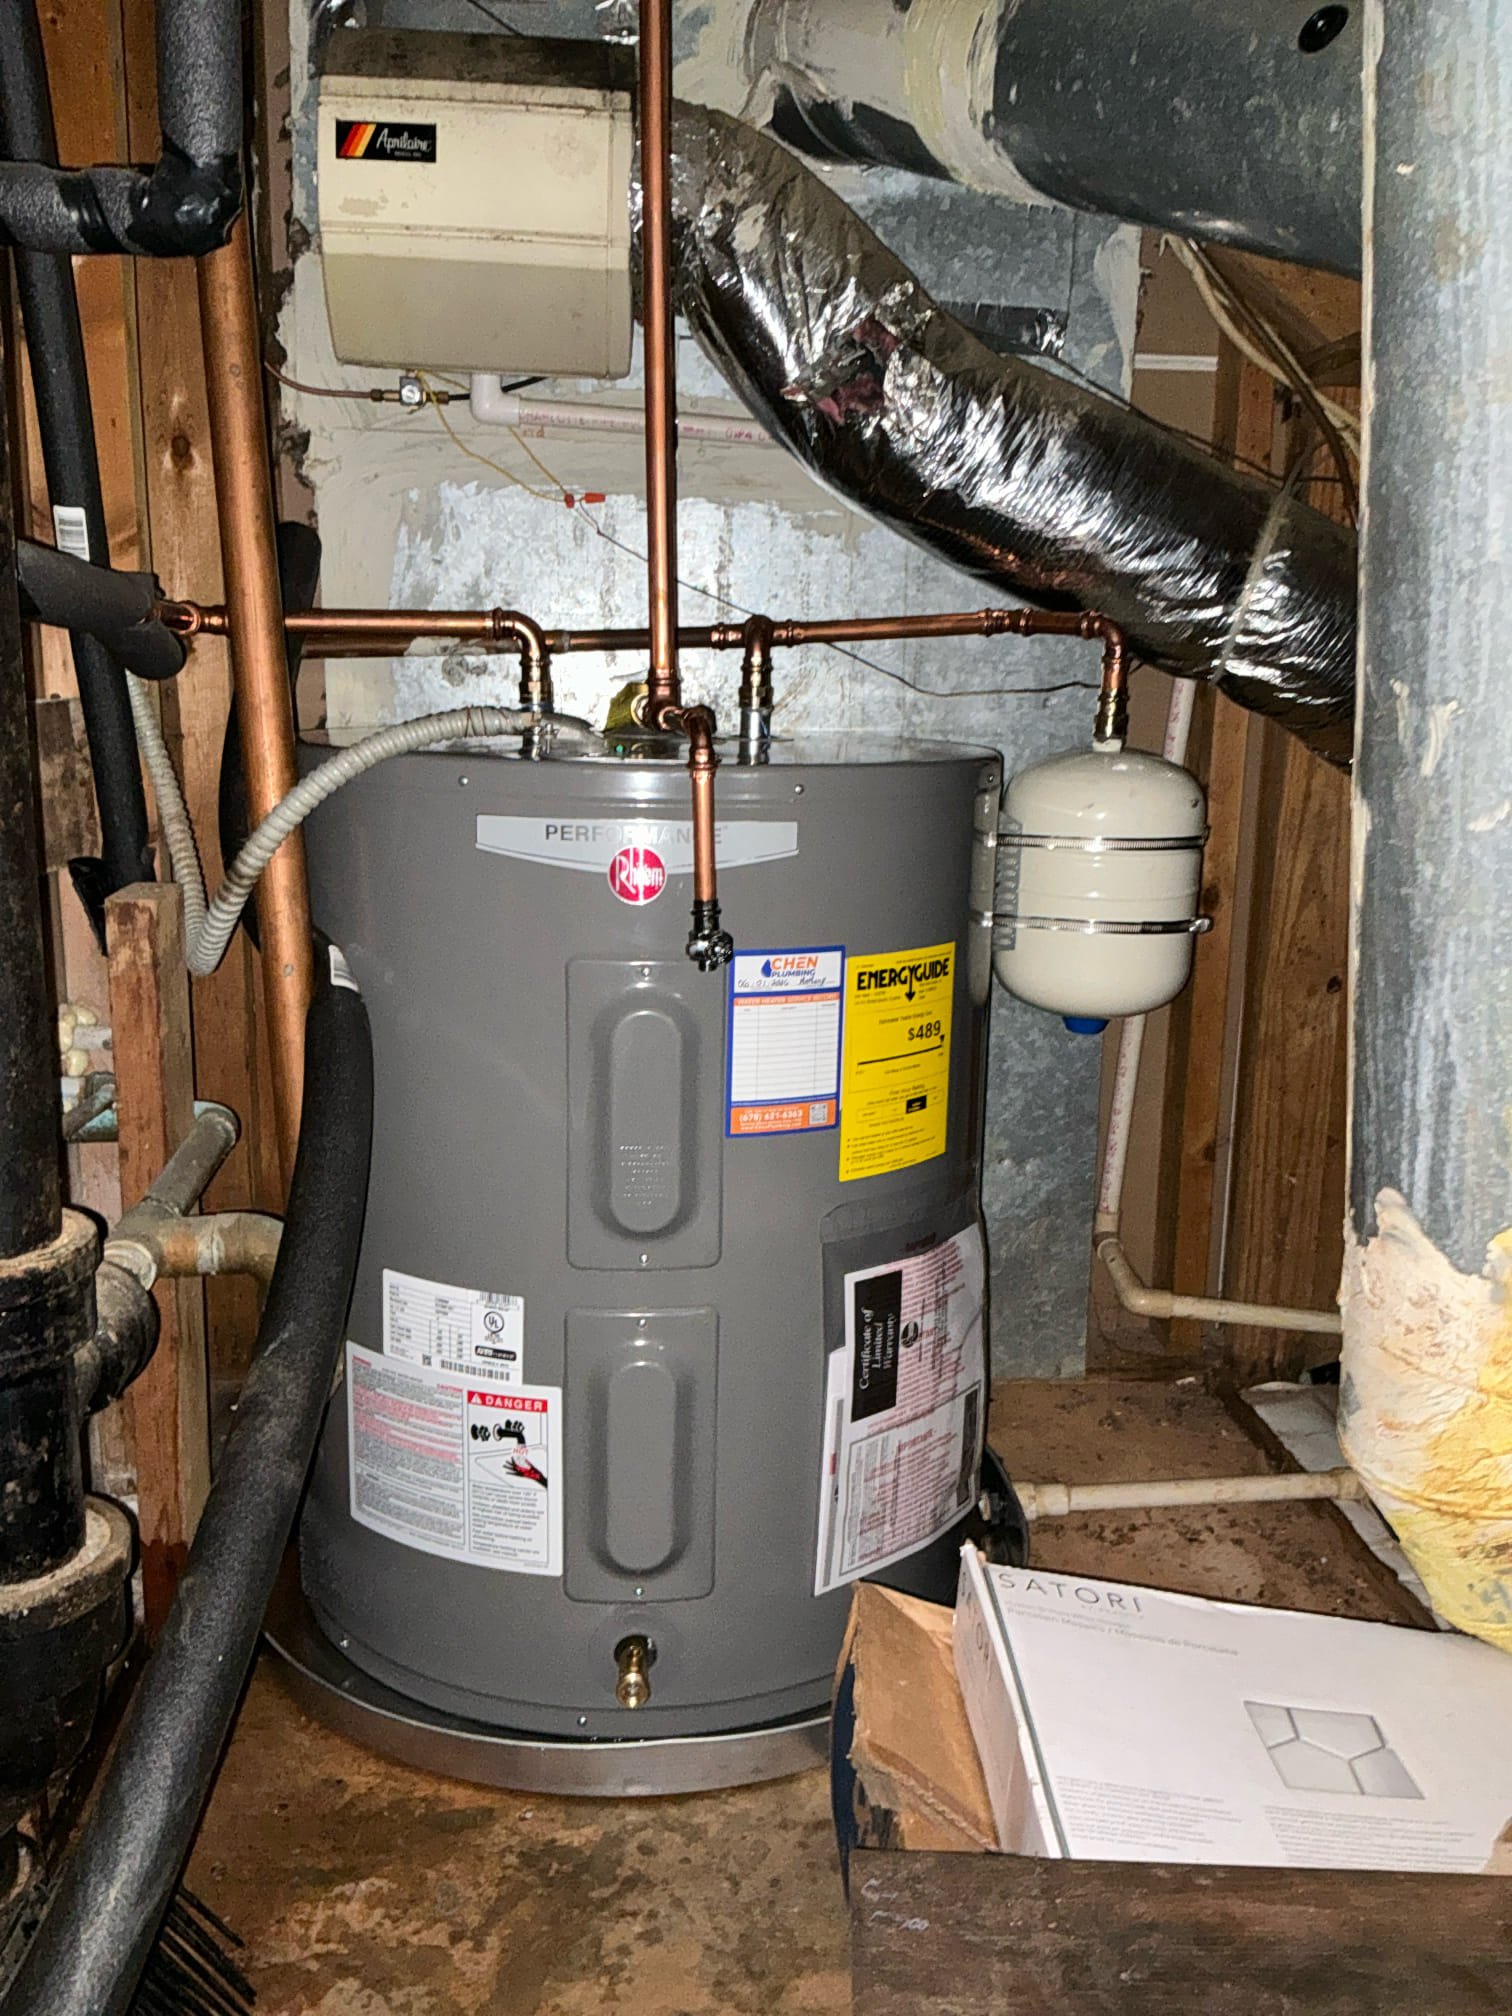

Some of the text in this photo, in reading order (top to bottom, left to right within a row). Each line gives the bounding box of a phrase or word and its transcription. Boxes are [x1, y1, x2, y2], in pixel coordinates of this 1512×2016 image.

[376, 127, 432, 154] Aprilaire
[771, 956, 818, 970] CHEN
[771, 968, 815, 978] PLUMBING
[907, 1020, 942, 1041] $489
[488, 1316, 500, 1329] UL
[858, 1307, 874, 1390] Certificate of
[871, 1321, 884, 1369] Limited
[883, 1312, 897, 1370] Warranty
[485, 1396, 543, 1411] DANGER
[997, 1573, 1142, 1613] SATORI
